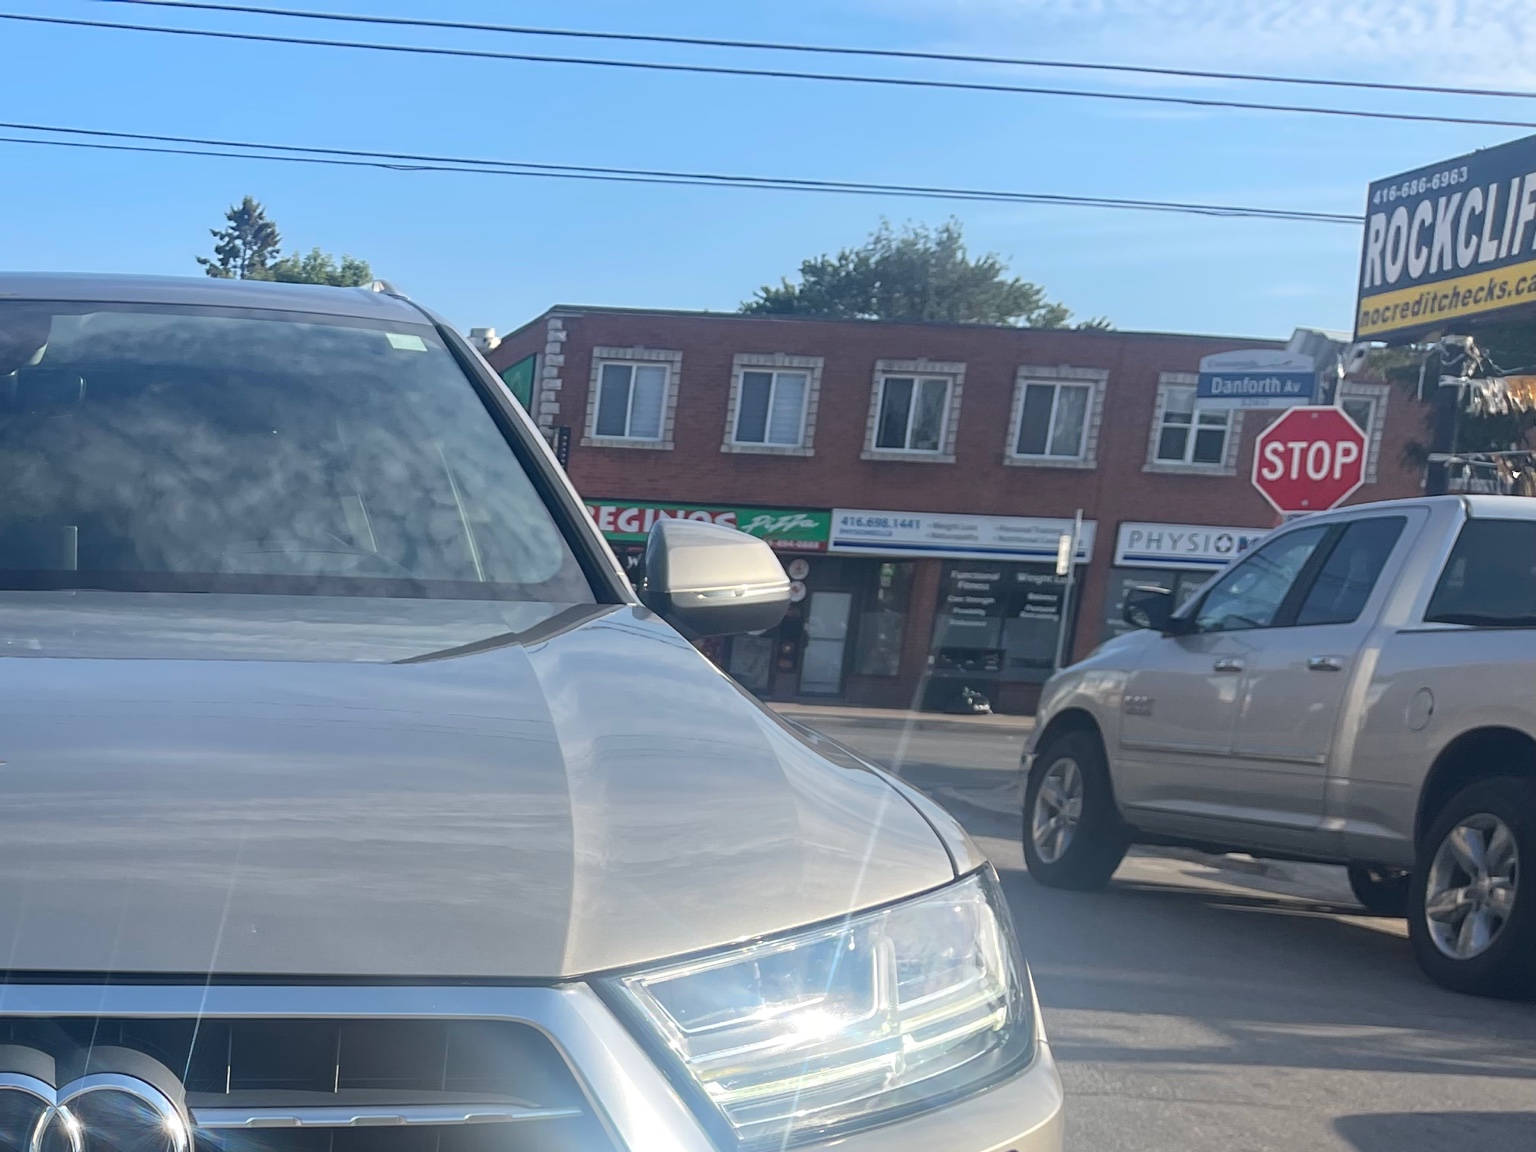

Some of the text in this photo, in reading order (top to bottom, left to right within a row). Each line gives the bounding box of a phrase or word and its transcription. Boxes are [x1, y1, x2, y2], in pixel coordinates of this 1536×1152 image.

[1373, 166, 1468, 205] 416-686-6963
[1364, 172, 1536, 288] ROCKCLIF
[1210, 376, 1302, 395] Danforth Av
[1261, 440, 1359, 481] STOP
